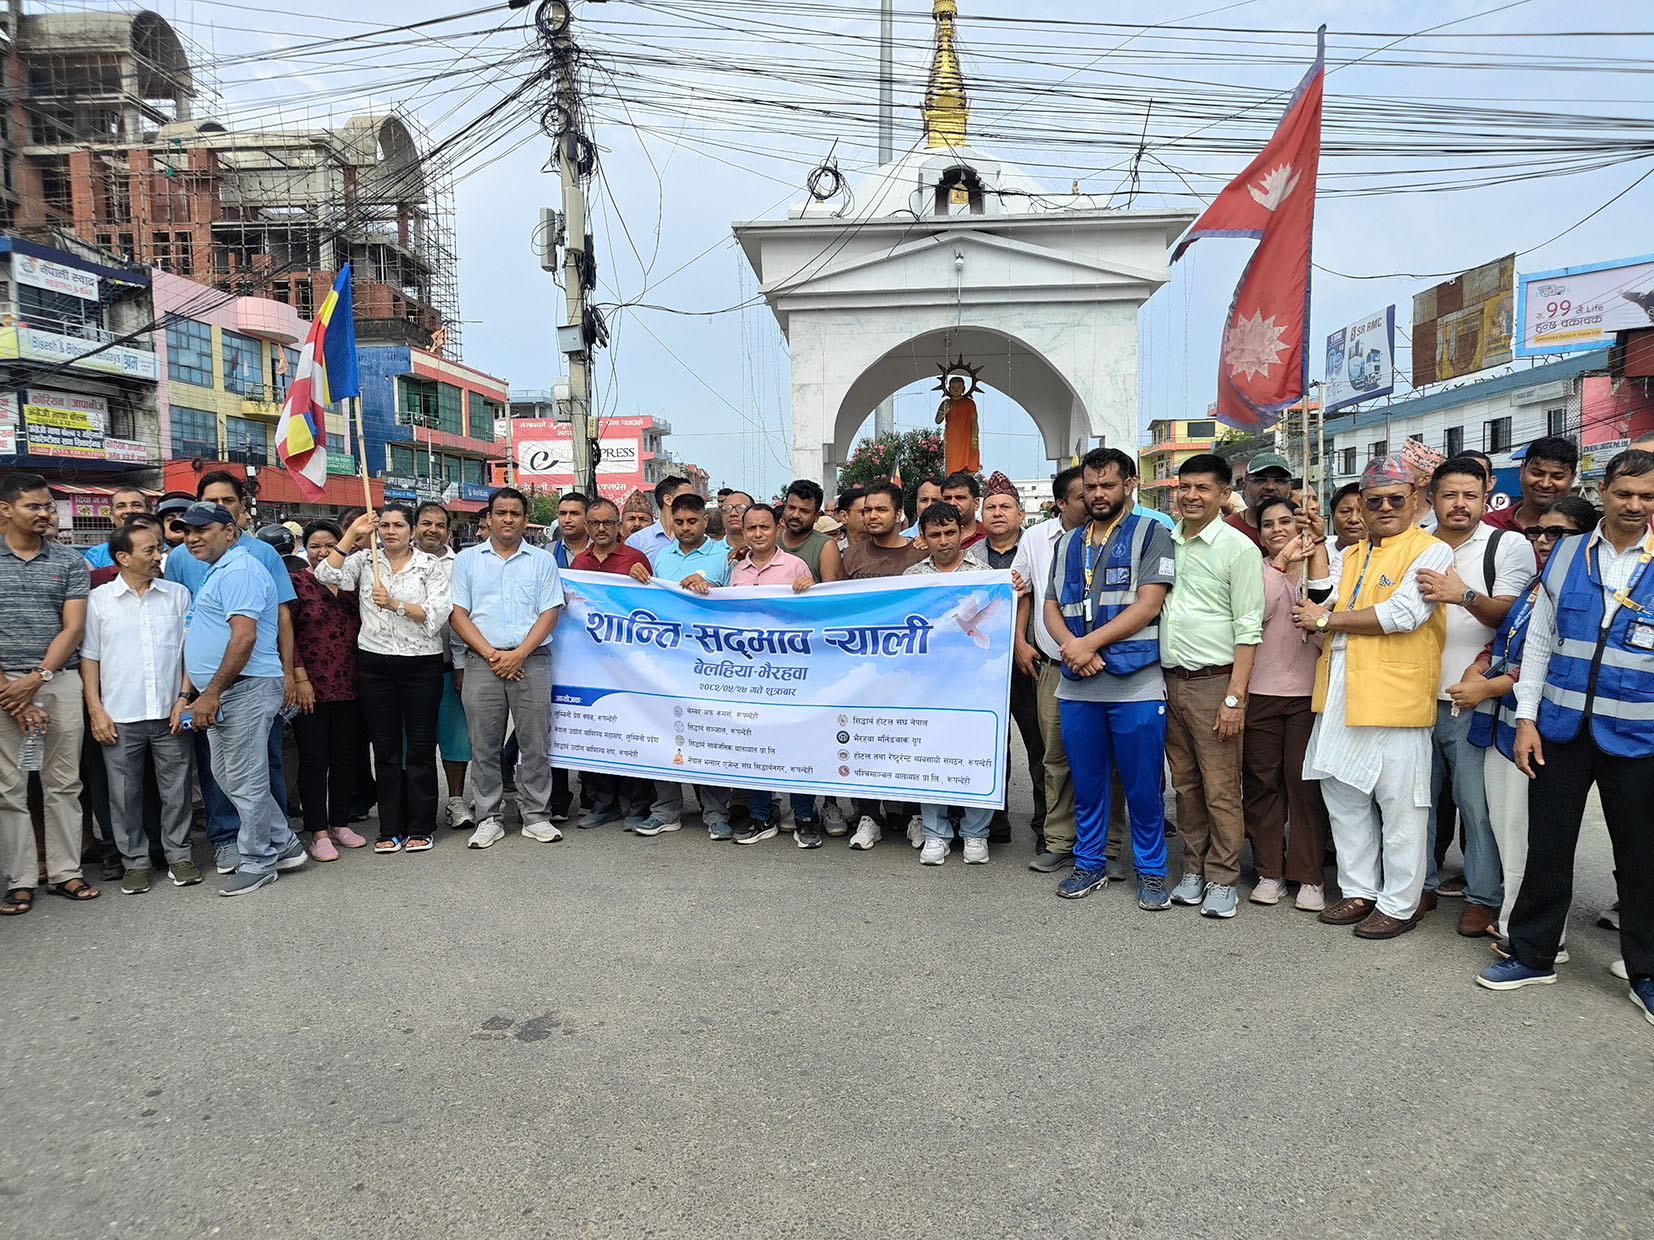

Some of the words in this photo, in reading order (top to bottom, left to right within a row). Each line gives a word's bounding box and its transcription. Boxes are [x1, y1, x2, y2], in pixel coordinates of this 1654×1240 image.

[40, 263, 69, 280] नेपाली
[72, 272, 95, 288] स्वाद
[45, 279, 72, 291] RESTRO
[80, 286, 94, 297] BAR
[1546, 300, 1572, 318] 99
[1586, 304, 1604, 313] Life
[1356, 325, 1366, 337] SR
[1366, 317, 1382, 332] RMC
[1535, 320, 1558, 334] हुन्छ
[1561, 315, 1603, 328] चकाचक
[32, 335, 57, 352] Bisesh
[32, 393, 65, 407] कोरियन
[70, 397, 105, 411] जापानीज
[600, 447, 635, 458] PRESS
[586, 608, 814, 660] शान्ति-सद्भाव
[693, 658, 808, 681] बेलहिया-भैरहवा
[699, 683, 747, 694] २०८२/०५/२७
[749, 685, 763, 695] गते
[554, 710, 572, 720] लुम्बिनी
[703, 708, 714, 716] अफ
[687, 723, 704, 732] सिद्धार्थ
[853, 715, 874, 726] सिद्धार्थ
[876, 717, 894, 727] होटल
[896, 718, 908, 726] संघ
[910, 717, 928, 727] नेपाल
[554, 726, 567, 734] नेपाल
[568, 728, 583, 736] उद्योग
[625, 732, 645, 743] लुम्बिनी
[853, 733, 875, 744] भैरहवा
[571, 744, 585, 752] उद्योग
[688, 739, 705, 749] सिद्धार्थ
[706, 741, 733, 751] सार्वजनिक
[734, 745, 758, 753] यातायात
[687, 756, 702, 765] नेपाल
[704, 758, 721, 768] भन्सार
[722, 760, 739, 769] एजेन्ट
[741, 762, 752, 770] संघ
[854, 751, 871, 760] होटल
[873, 752, 886, 760] तथा
[914, 755, 941, 764] व्यवसायी
[854, 768, 892, 779] पश्चिमाञ्चल
[894, 772, 920, 781] यातायात
